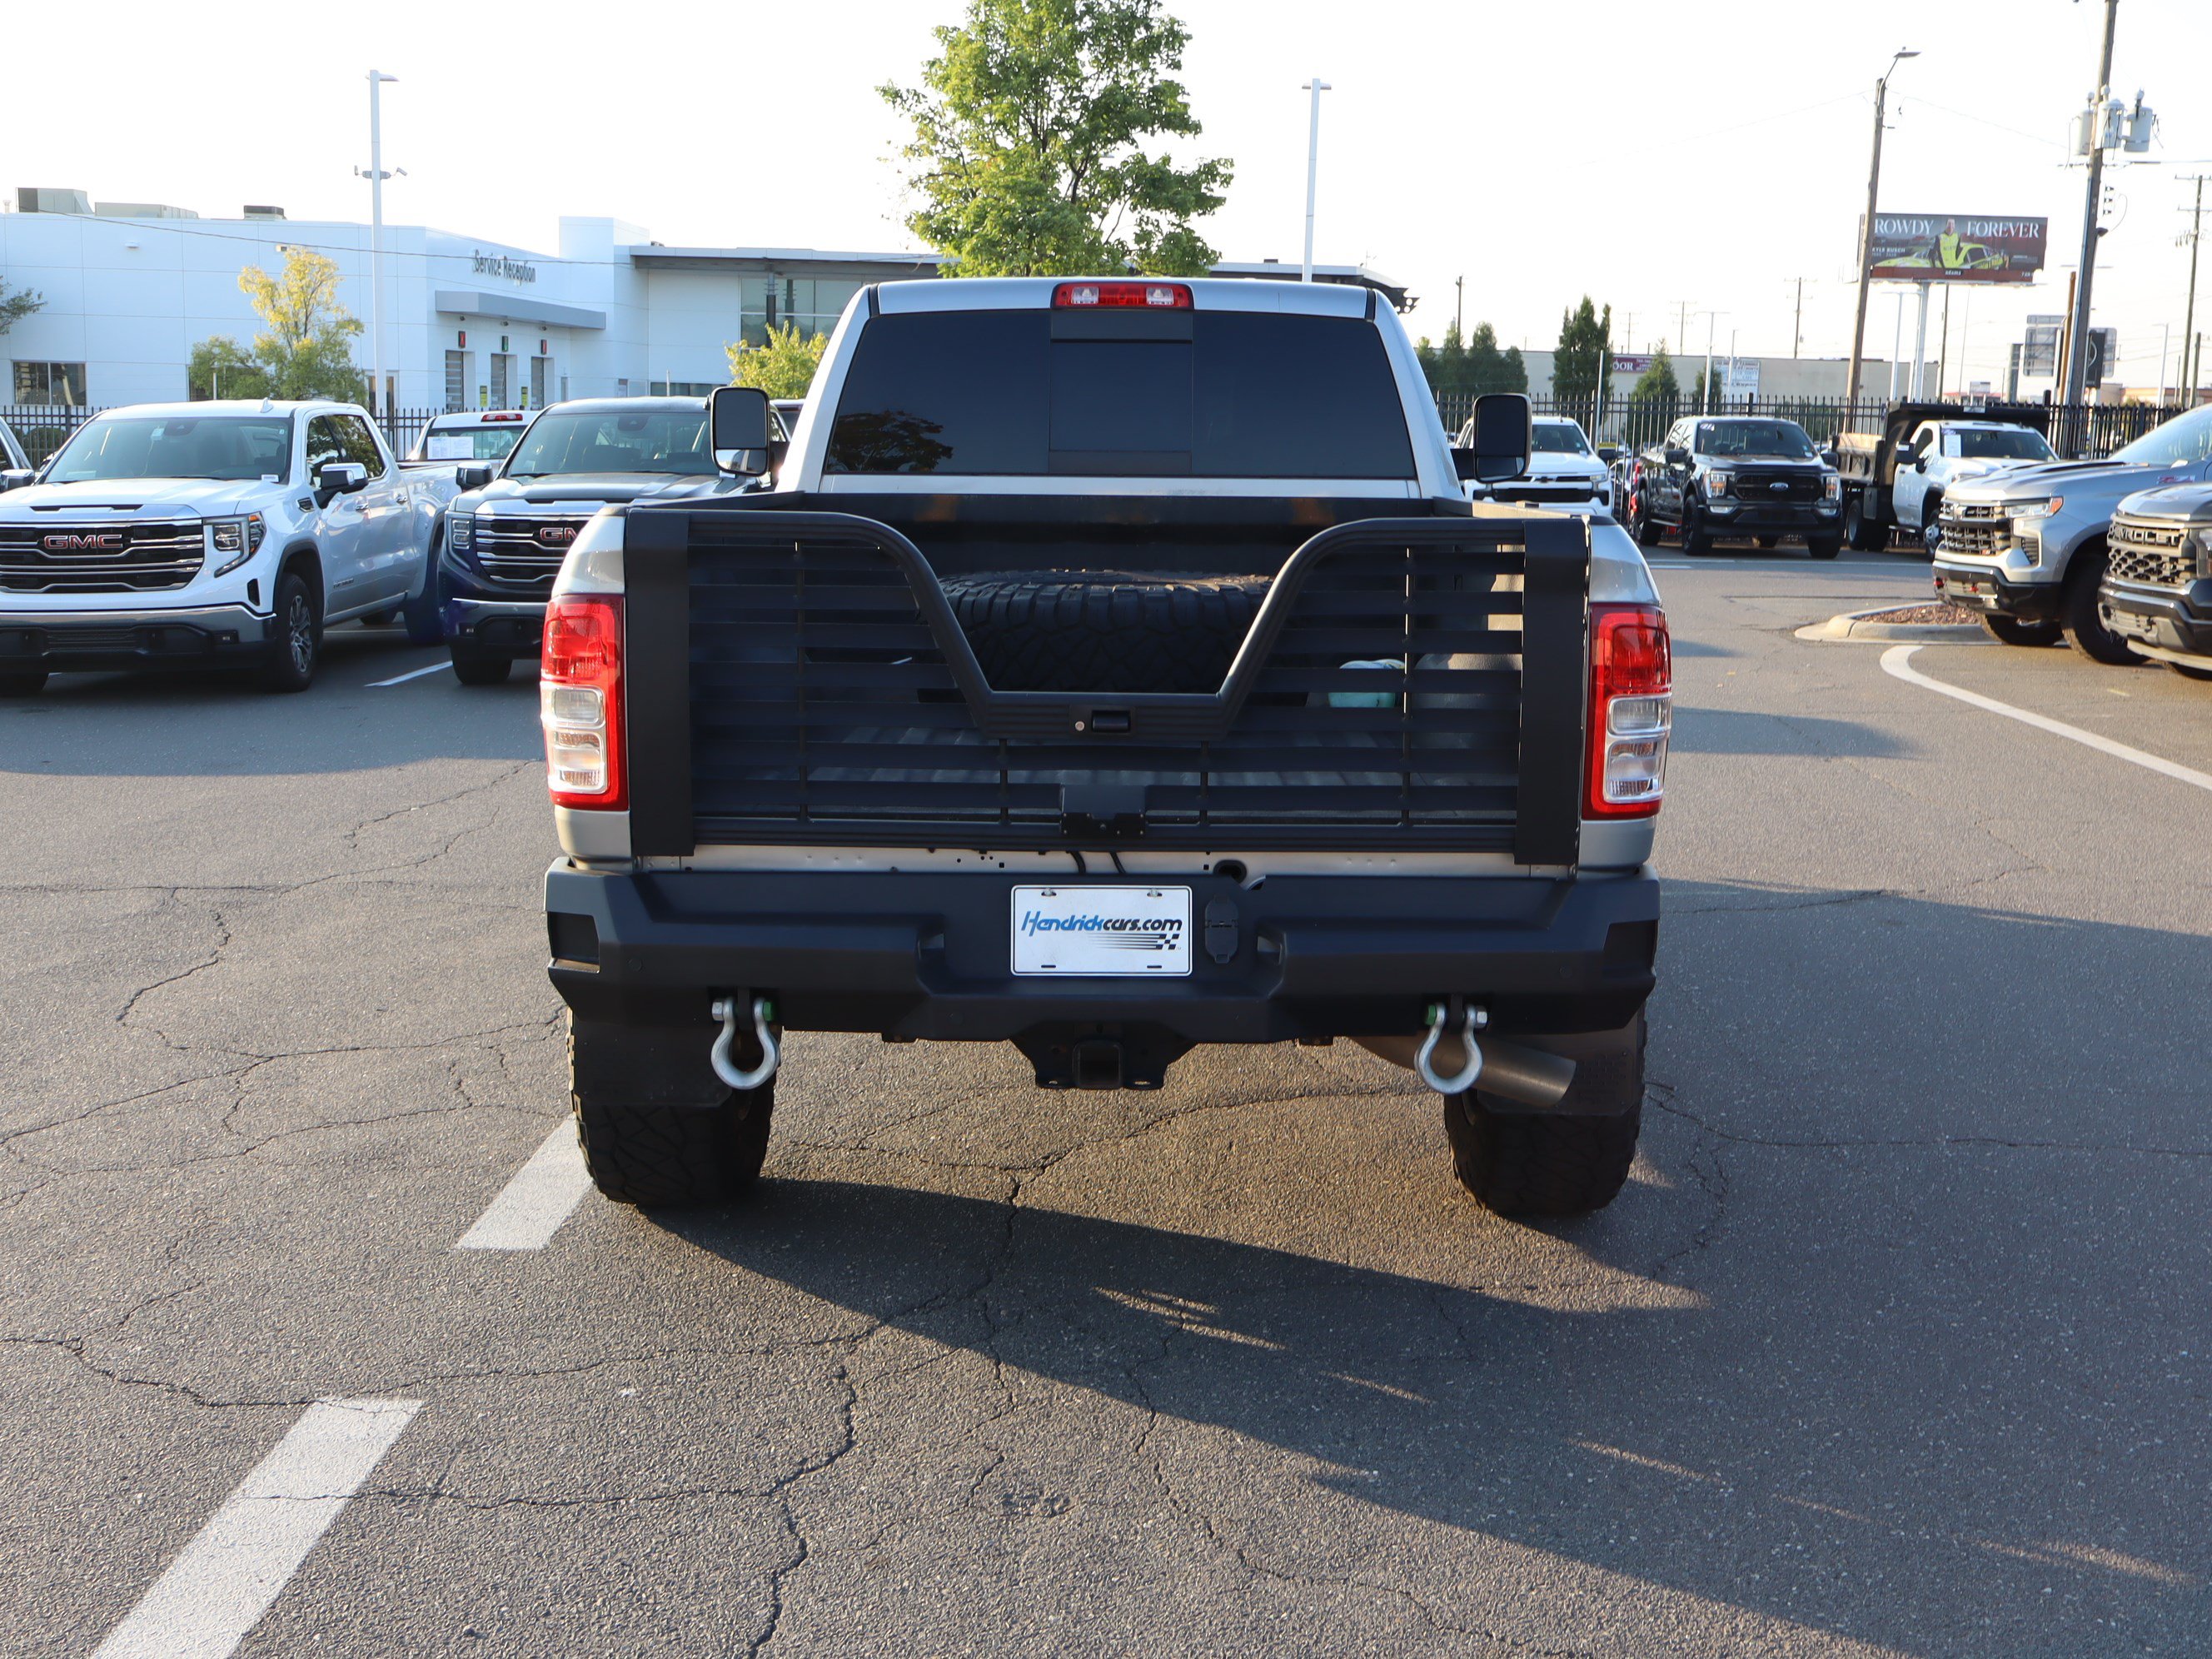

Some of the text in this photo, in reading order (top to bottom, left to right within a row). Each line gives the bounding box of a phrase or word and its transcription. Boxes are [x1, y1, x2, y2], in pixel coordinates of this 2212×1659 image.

[1874, 218, 2040, 239] ROWDY FOREVER
[475, 249, 536, 286] Service Reception
[1612, 361, 1633, 371] OOR
[44, 534, 123, 550] GMC
[1021, 911, 1183, 937] Hendrickcars.com
